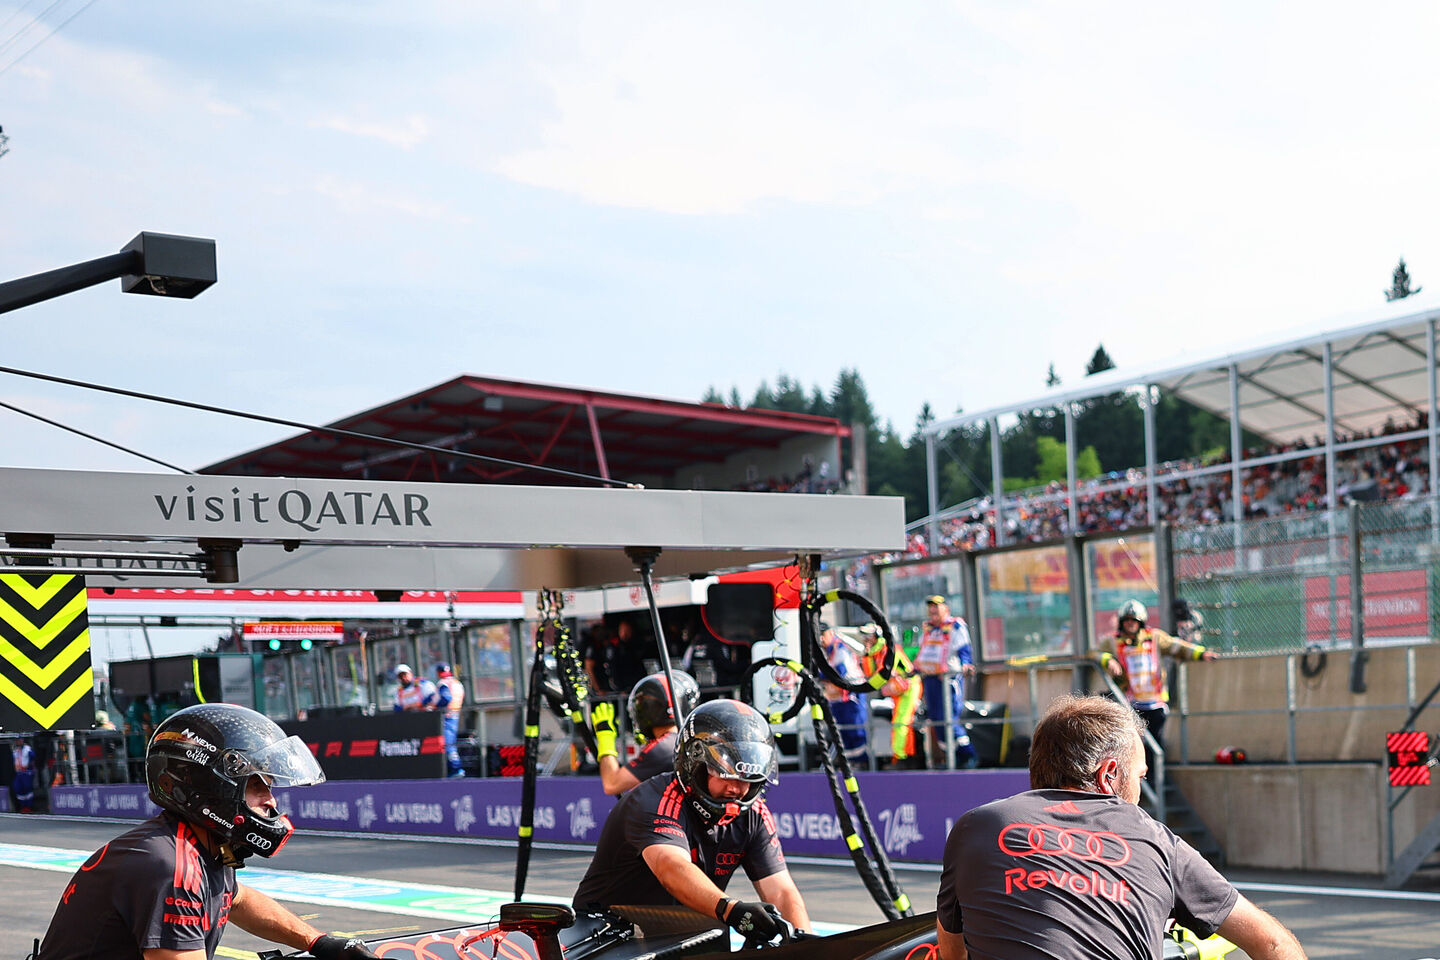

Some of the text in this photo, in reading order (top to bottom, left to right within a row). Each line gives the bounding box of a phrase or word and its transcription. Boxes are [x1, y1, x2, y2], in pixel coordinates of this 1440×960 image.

[194, 735, 217, 753] NEXO
[208, 813, 235, 830] Castrol
[486, 805, 512, 826] LAS
[512, 806, 556, 829] VAS
[1004, 867, 1132, 903] Revolut
